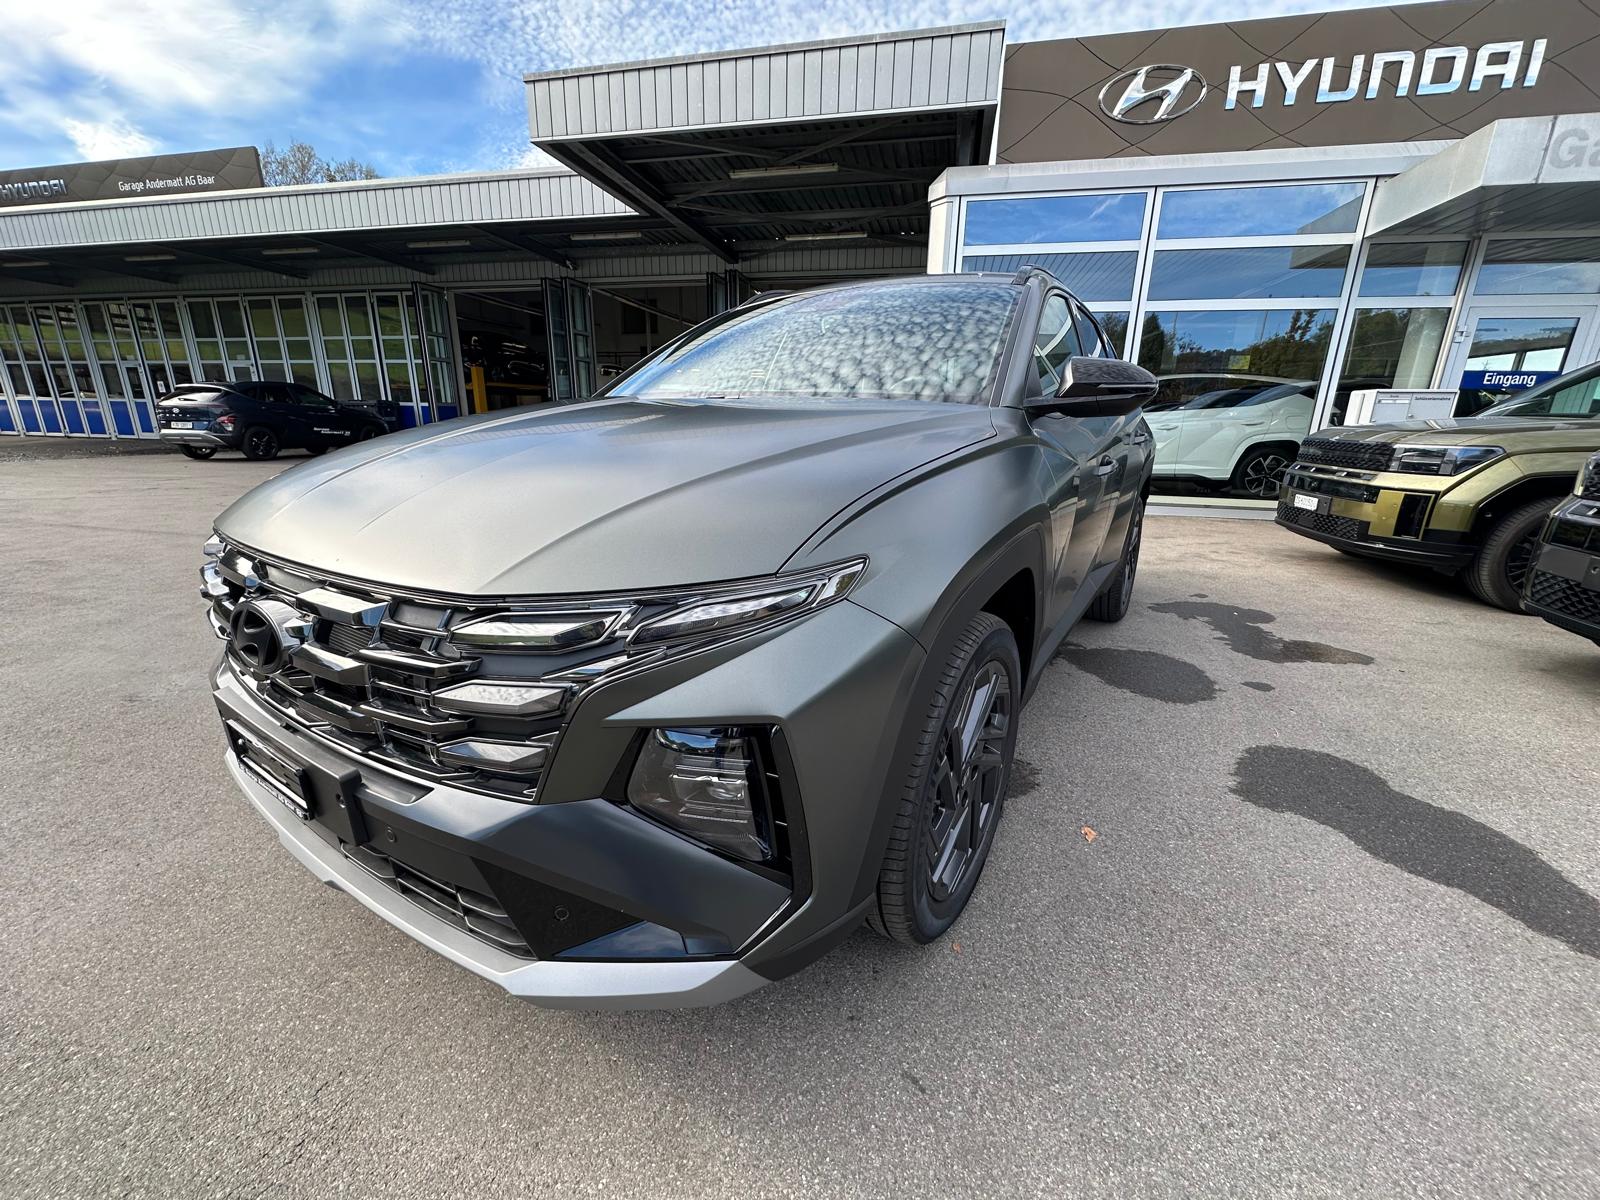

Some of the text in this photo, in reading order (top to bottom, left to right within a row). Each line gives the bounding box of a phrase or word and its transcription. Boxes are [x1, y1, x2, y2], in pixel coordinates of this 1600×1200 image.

[1224, 38, 1548, 110] HYUNDAI
[0, 179, 67, 199] HYUNDAI
[118, 175, 215, 192] Garage Andermatt AG Baar
[1483, 372, 1537, 387] Eingang
